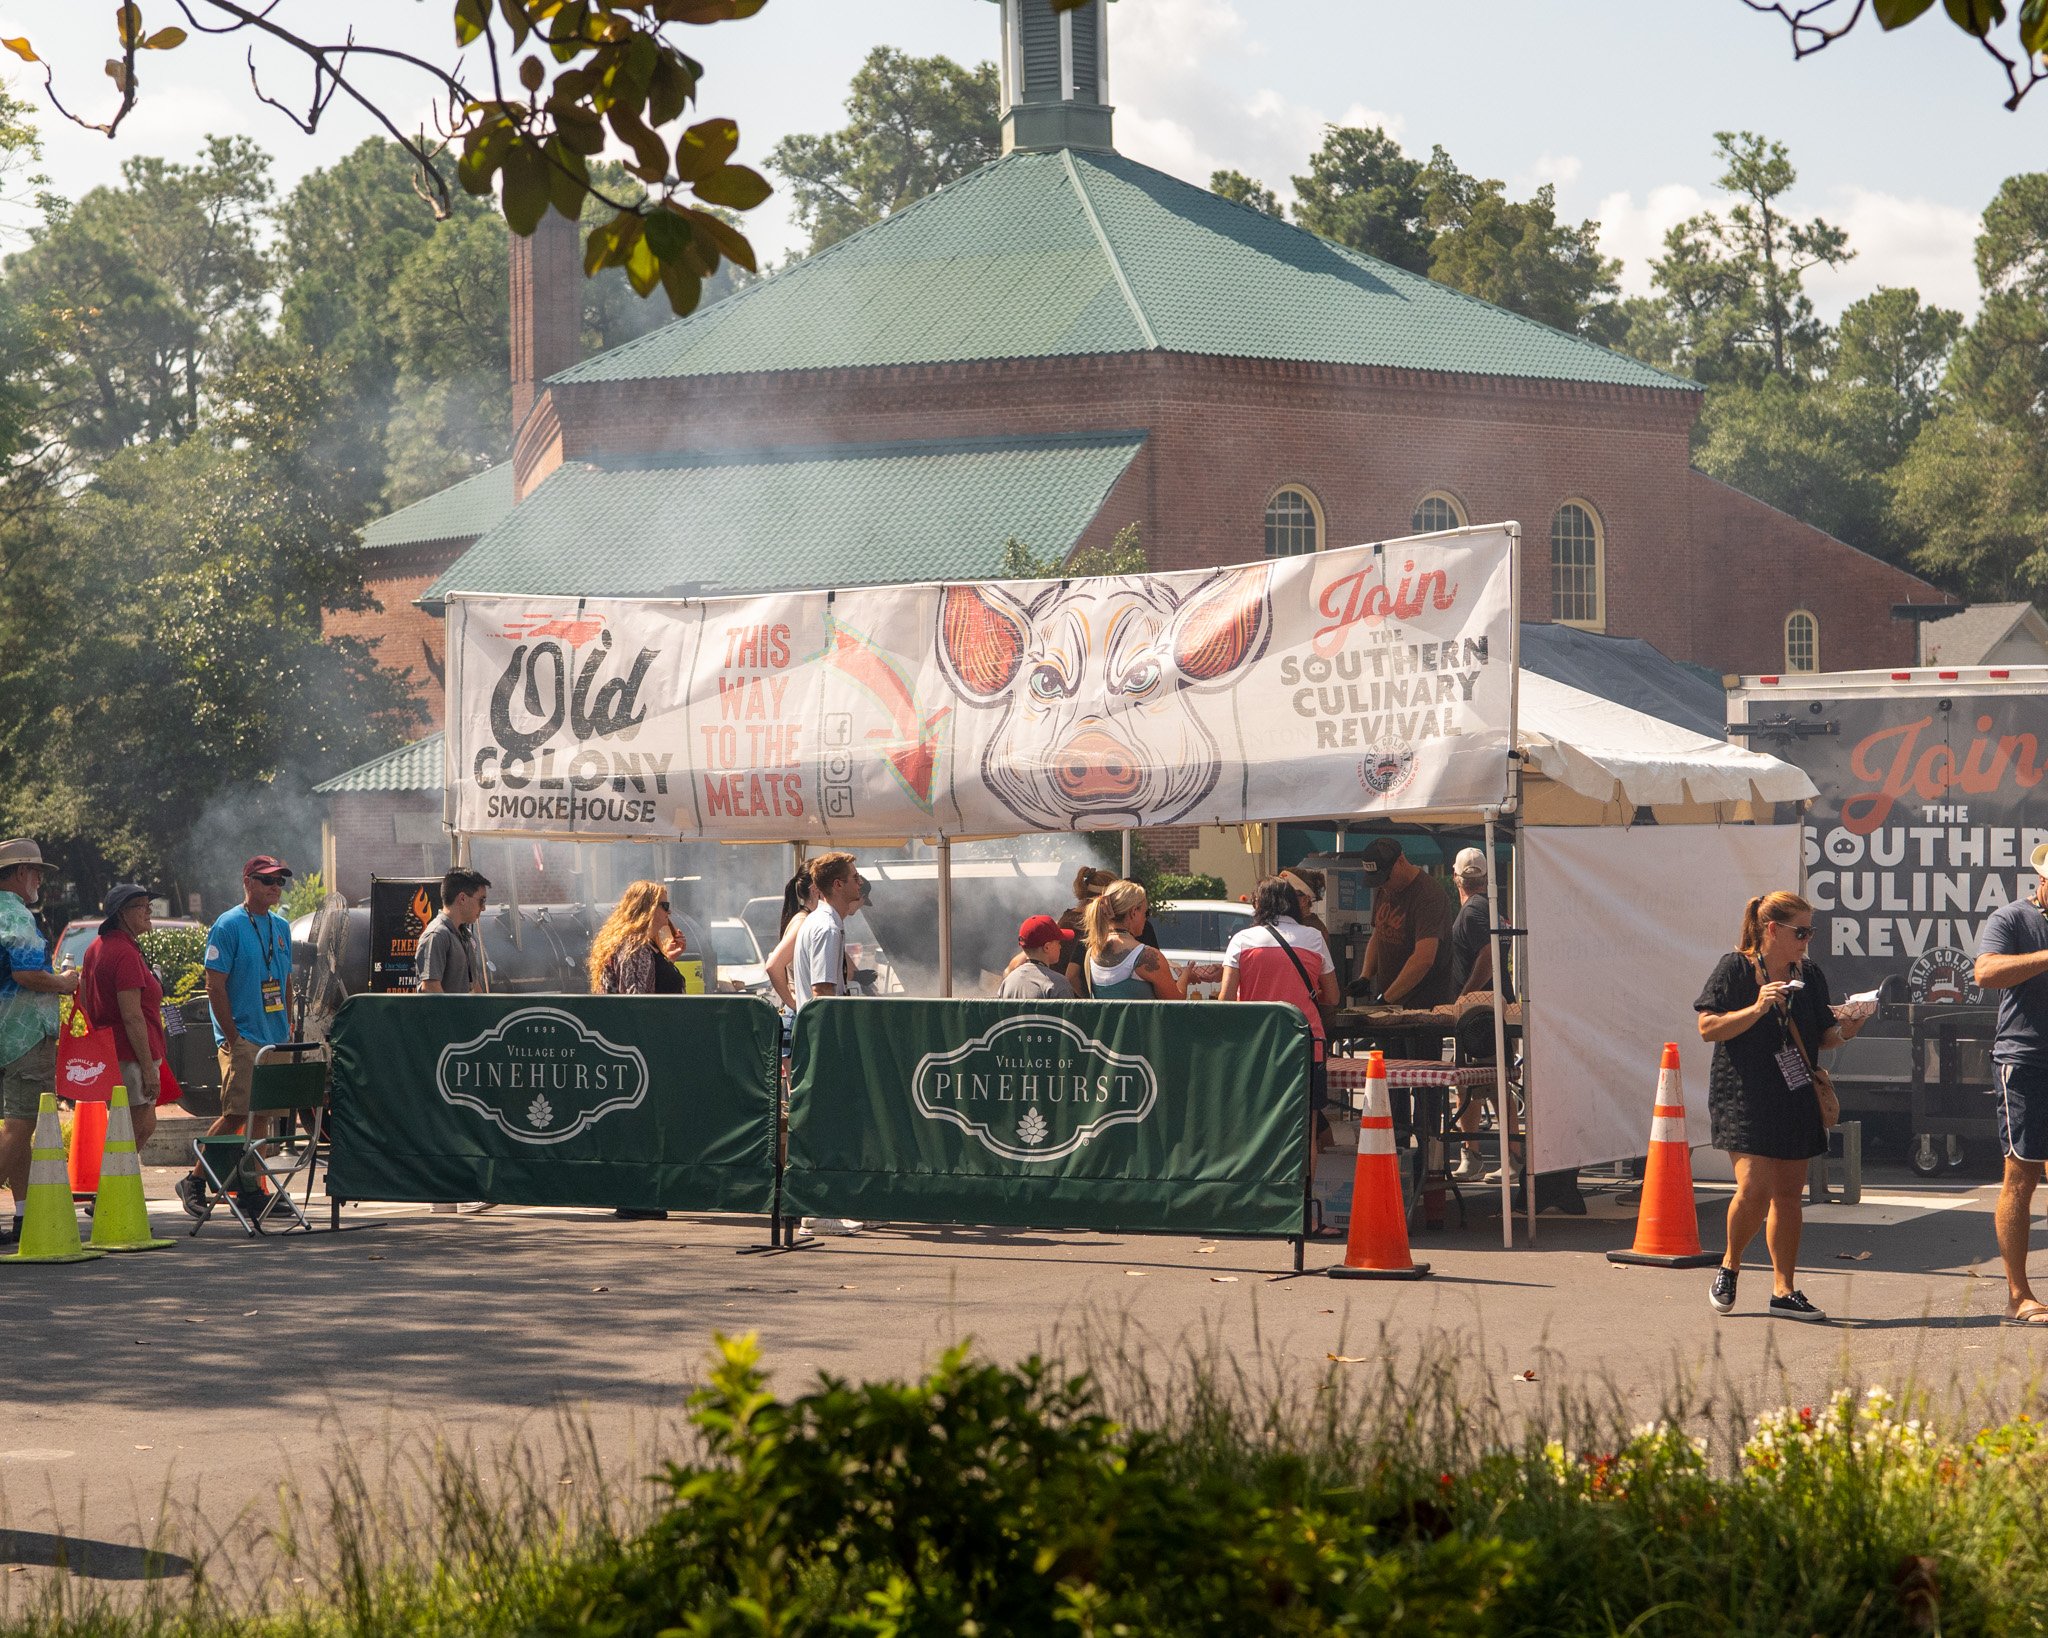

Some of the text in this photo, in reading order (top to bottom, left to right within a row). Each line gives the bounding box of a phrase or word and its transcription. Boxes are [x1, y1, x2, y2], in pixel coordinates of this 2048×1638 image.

[1312, 559, 1458, 658] Join
[724, 624, 790, 668] THIS
[1369, 629, 1404, 644] THE
[1281, 636, 1488, 686] SOUTHERN
[491, 628, 661, 766] Old
[719, 677, 789, 720] WAY
[1293, 671, 1481, 717] CULINARY
[1316, 707, 1461, 749] REVIVAL
[701, 725, 801, 769] TO THE
[1367, 745, 1379, 764] OLD
[474, 747, 673, 795] COLONY
[1367, 767, 1408, 790] SMOKEHOUSE
[1841, 716, 2048, 834] Join
[487, 796, 656, 823] SMOKEHOUSE
[704, 773, 803, 817] MEATS
[1922, 805, 1968, 823] THE
[391, 939, 418, 951] PINEH
[1831, 917, 1987, 958] REVIV
[1912, 958, 1931, 985] OLD
[526, 1026, 556, 1034] 1895
[1018, 1035, 1052, 1043] 1895
[507, 1045, 576, 1058] VILLAGE OF
[996, 1055, 1074, 1068] VILLAGE OF
[456, 1062, 628, 1090] PINEHURST
[935, 1073, 1133, 1103] PINEHURST
